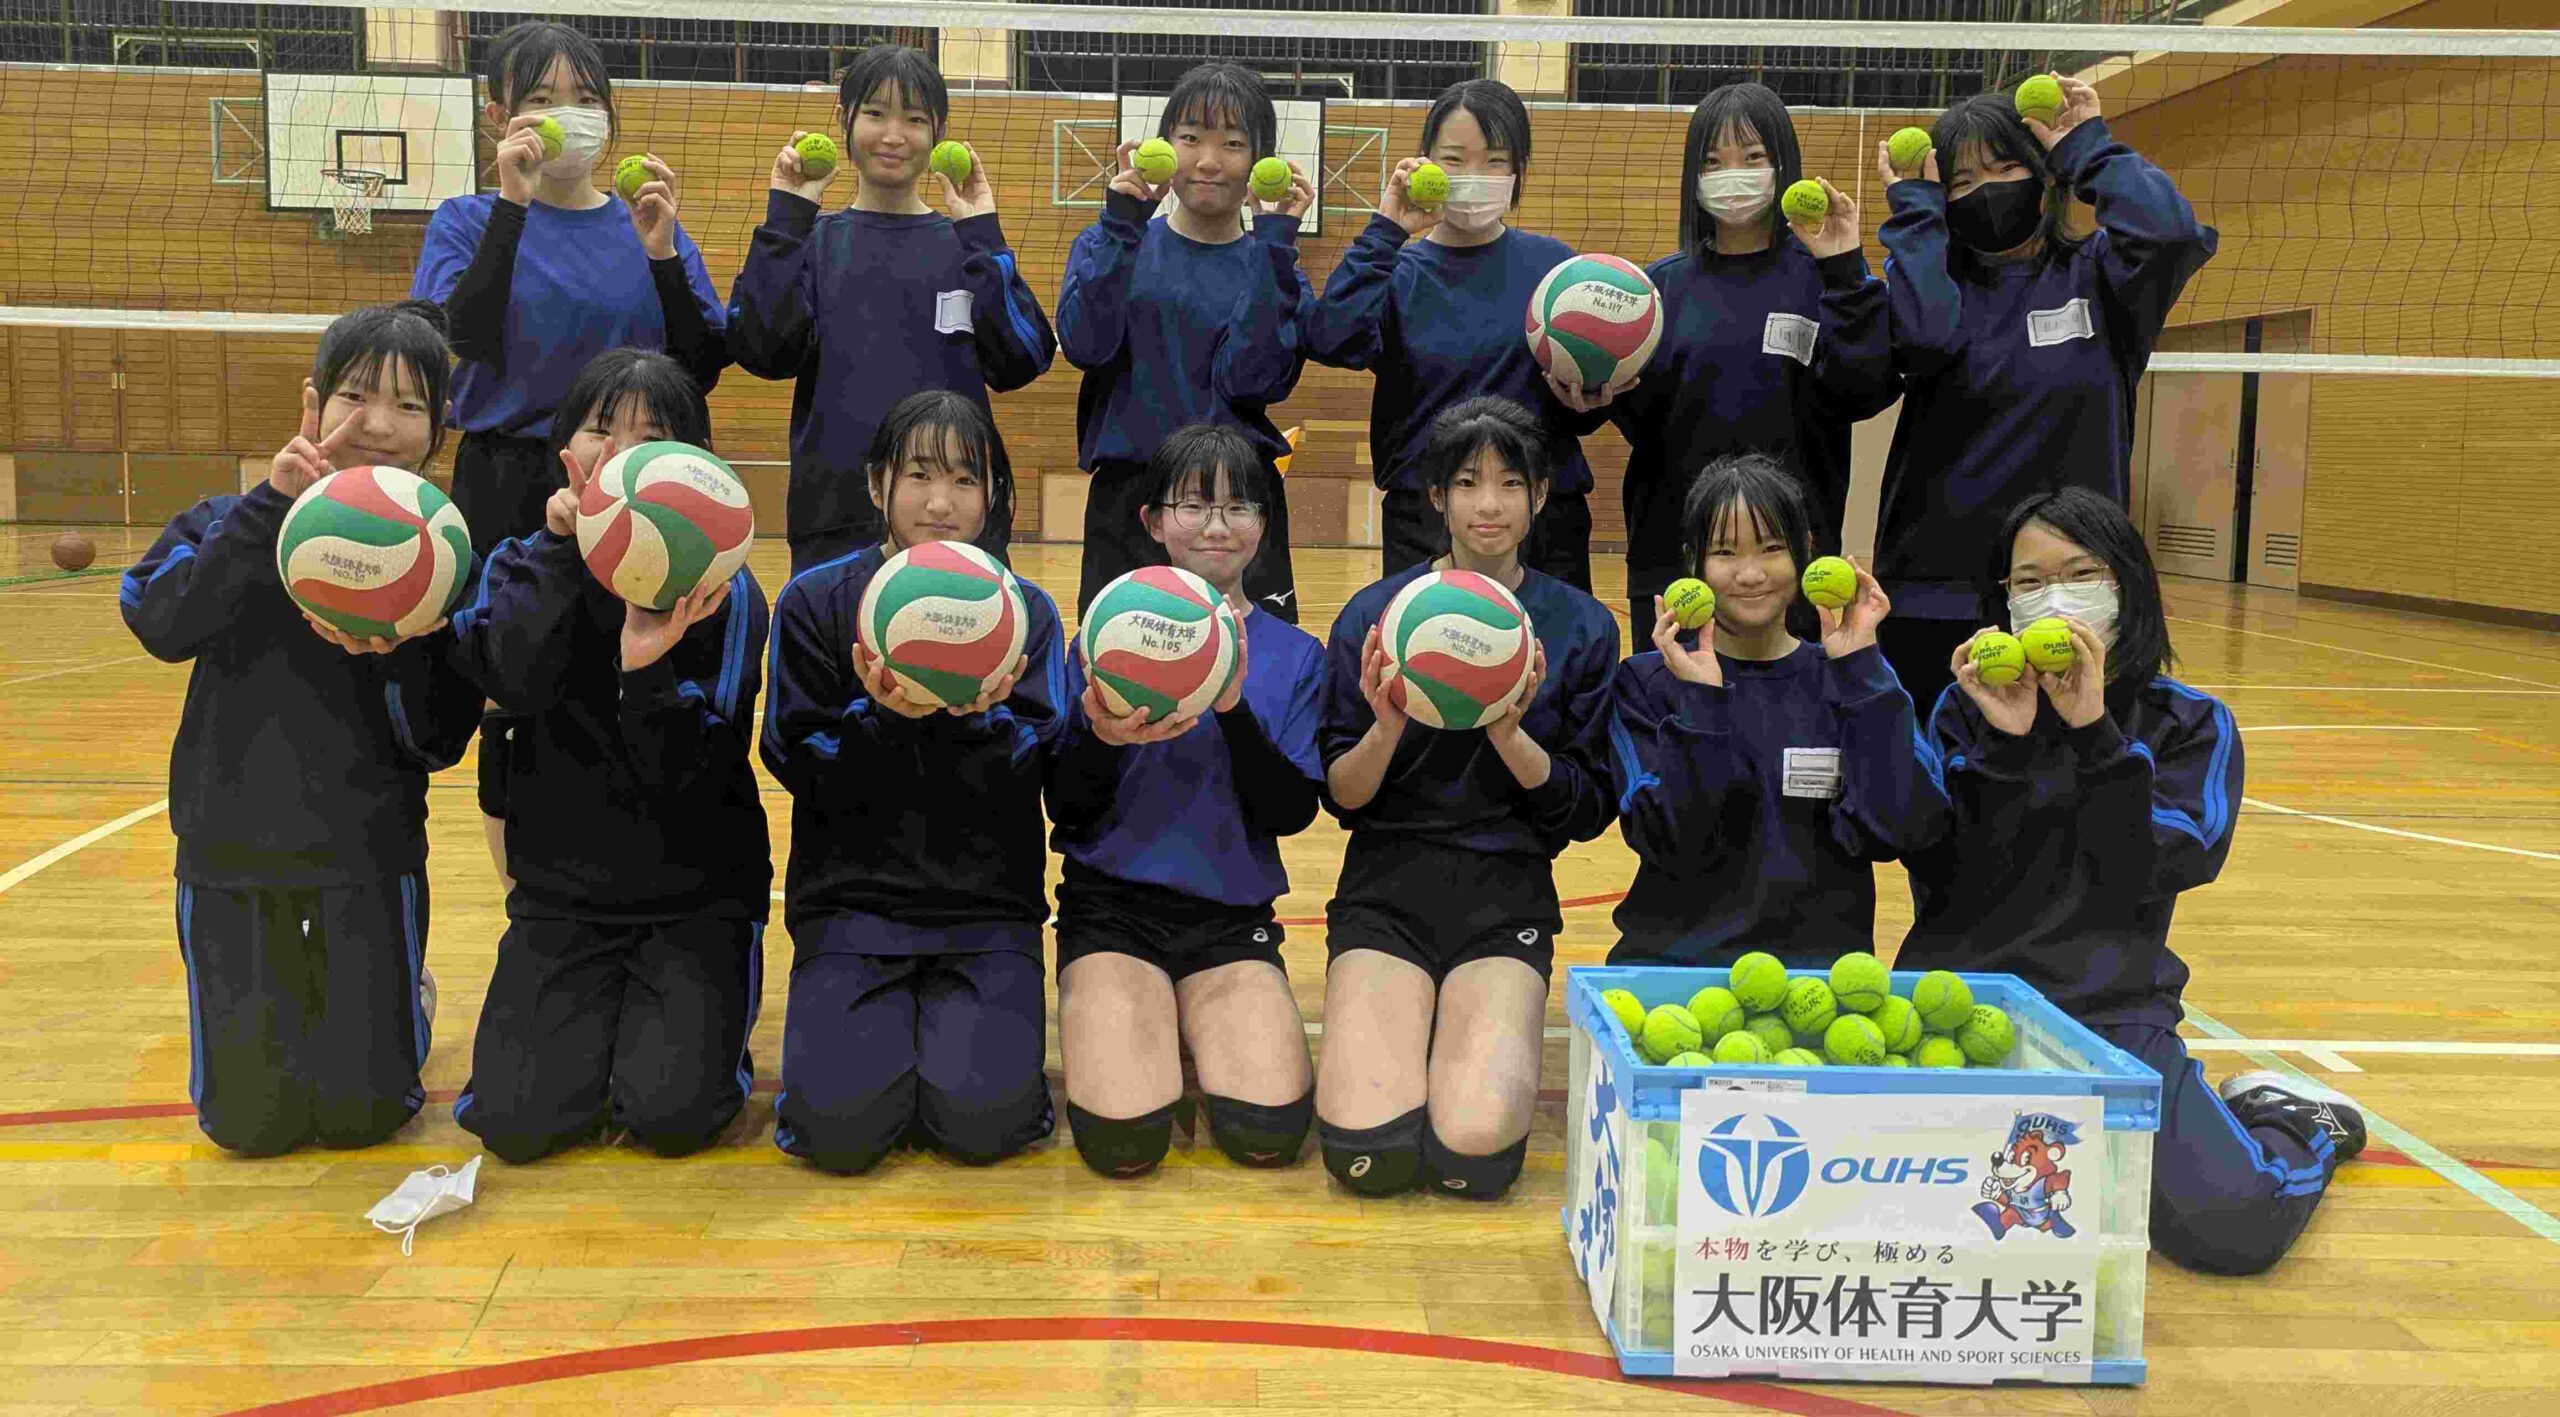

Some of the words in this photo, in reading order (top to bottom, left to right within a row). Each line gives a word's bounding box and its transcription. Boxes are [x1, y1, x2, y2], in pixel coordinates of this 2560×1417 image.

[1583, 283, 1638, 307] 大阪体育大学
[1674, 585, 1701, 608] DUNLOP
[1128, 613, 1196, 642] 大阪体育大学
[2017, 1116, 2069, 1135] OUHS
[1820, 1157, 1969, 1185] OUHS
[1691, 1273, 2083, 1343] 大阪体育大学
[1691, 1344, 1739, 1359] OSAKA
[1745, 1346, 1829, 1360] UNIVERSITY
[1834, 1347, 1854, 1360] OF
[1860, 1347, 1914, 1362] HEALTH
[1920, 1350, 1952, 1362] AND
[1957, 1351, 2004, 1364] SPORT
[2010, 1350, 2081, 1365] SCIENCES
